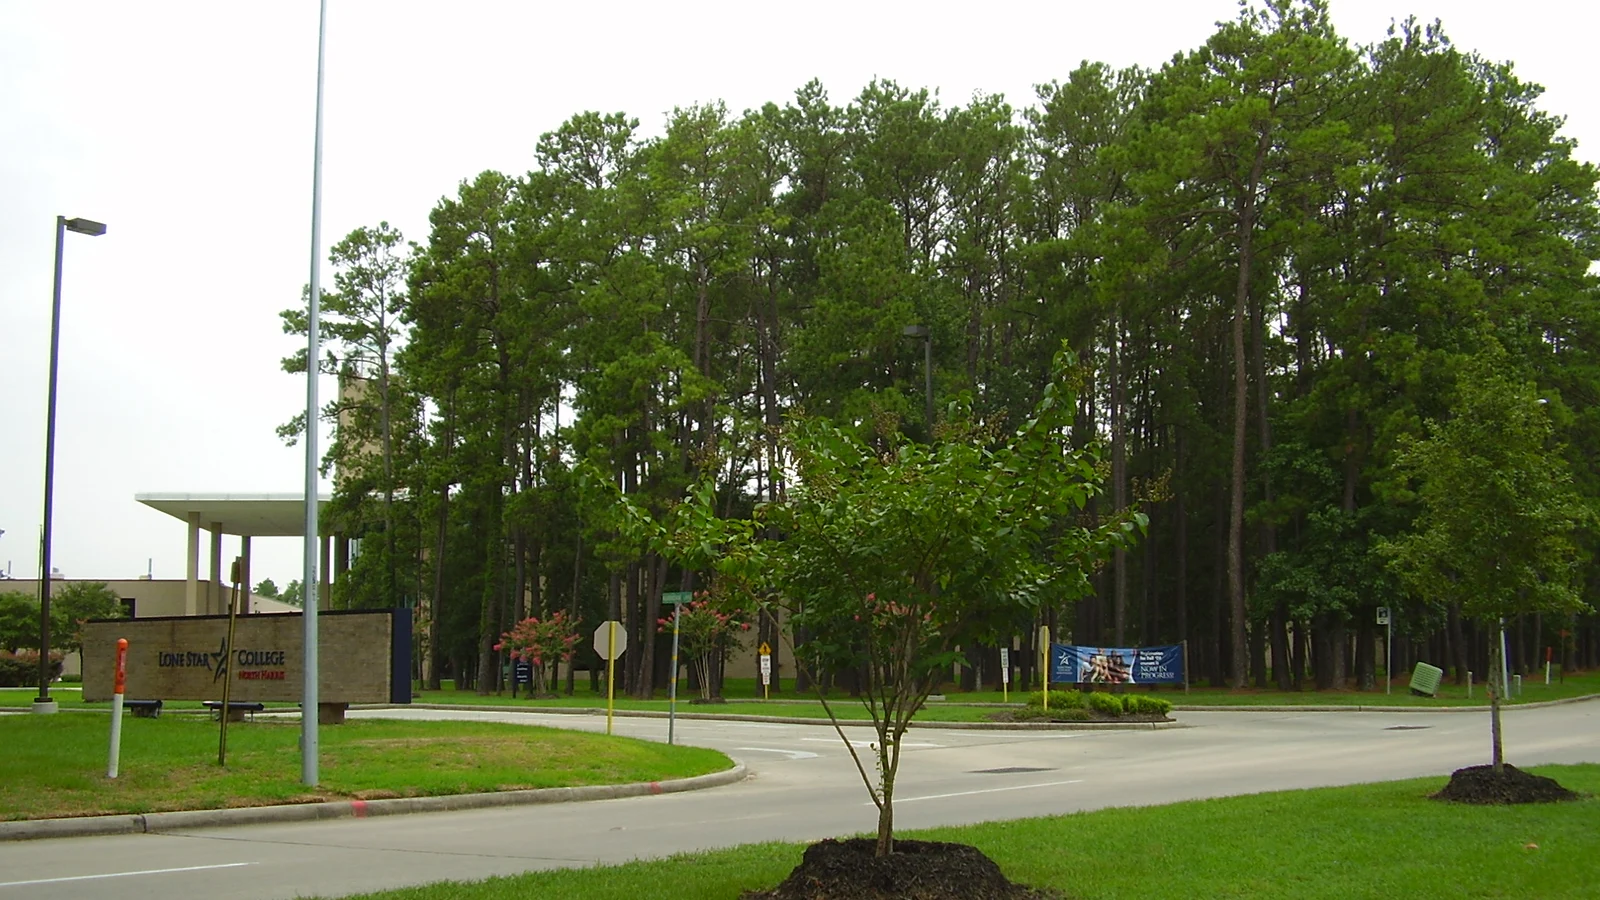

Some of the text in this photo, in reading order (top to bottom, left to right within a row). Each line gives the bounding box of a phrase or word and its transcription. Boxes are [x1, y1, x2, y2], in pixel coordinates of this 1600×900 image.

[158, 651, 211, 671] LONE STAR
[238, 649, 285, 666] COLLEGE
